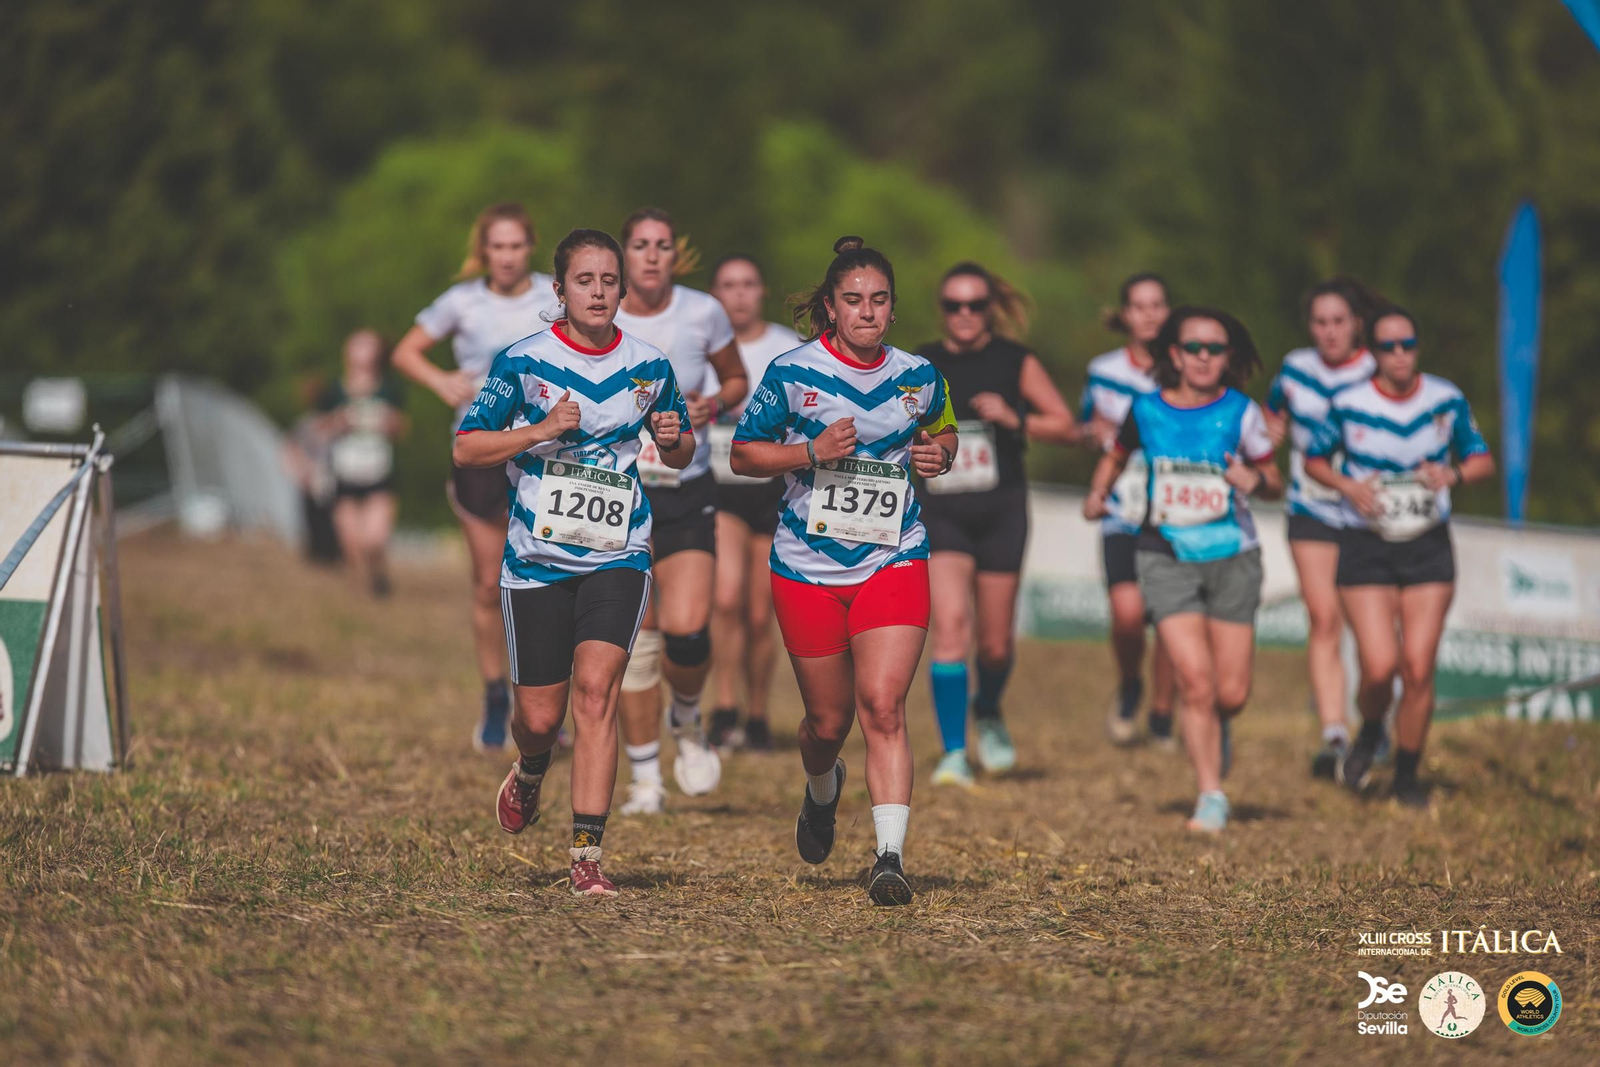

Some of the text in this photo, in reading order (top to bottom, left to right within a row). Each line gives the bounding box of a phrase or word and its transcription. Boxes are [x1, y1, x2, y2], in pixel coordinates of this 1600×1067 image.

[570, 466, 611, 484] ITÁLICA
[844, 460, 884, 475] ITÁLICA
[547, 489, 625, 527] 1208
[821, 484, 898, 518] 1379
[1161, 484, 1225, 513] 1490
